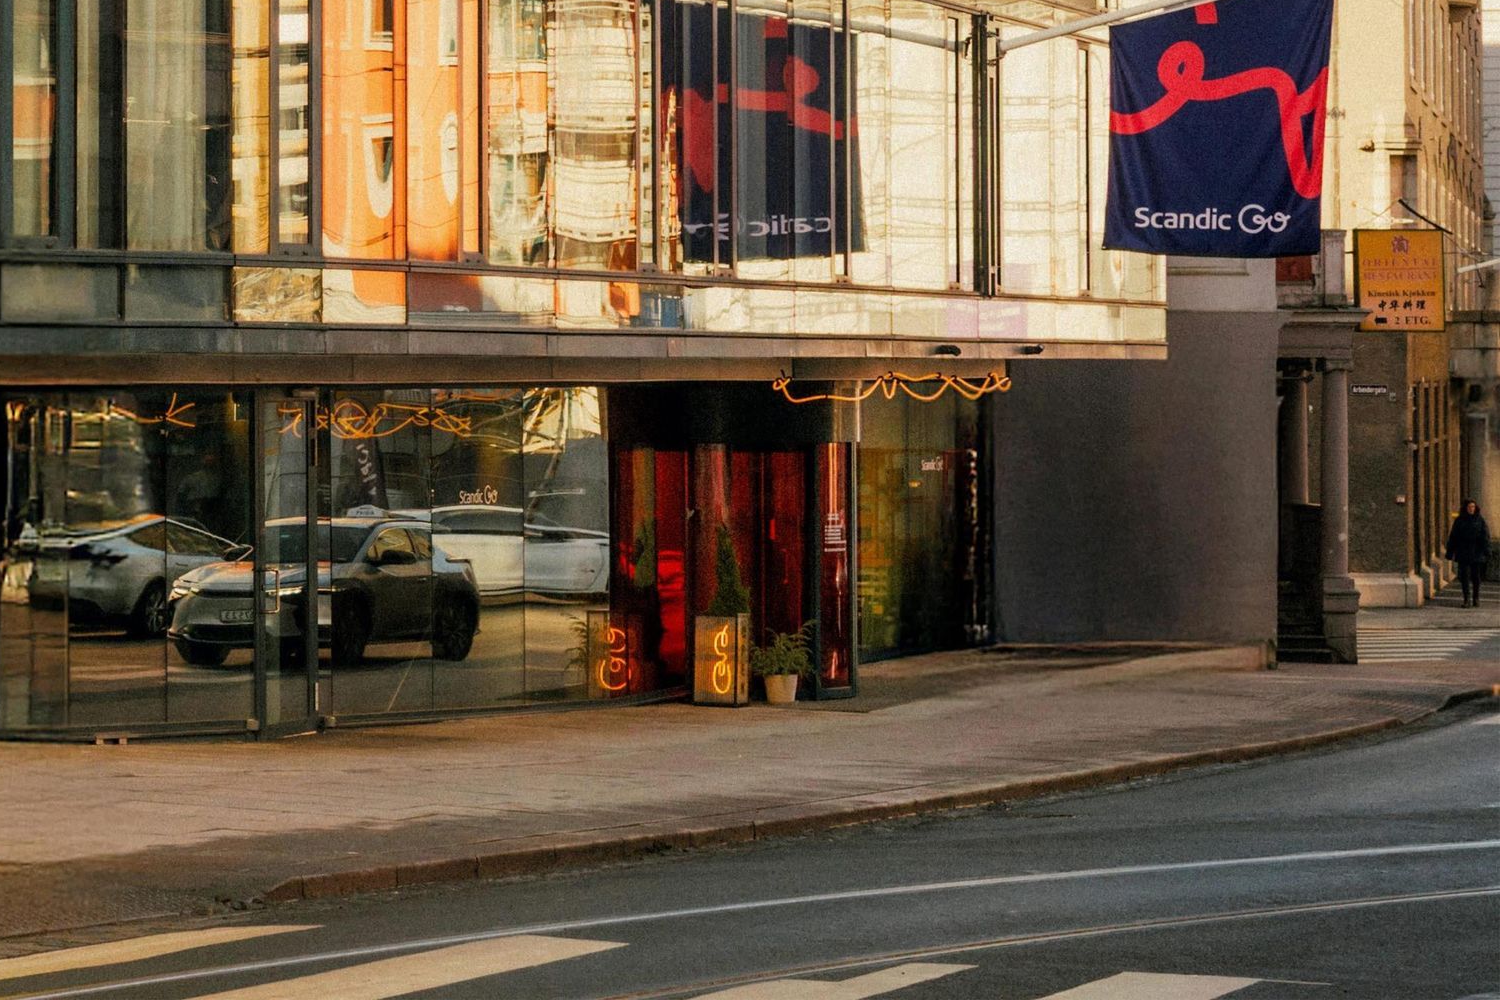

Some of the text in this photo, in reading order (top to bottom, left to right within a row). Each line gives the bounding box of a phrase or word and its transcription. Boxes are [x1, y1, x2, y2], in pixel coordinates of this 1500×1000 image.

[1134, 203, 1291, 234] Scandic Go
[1395, 316, 1432, 325] 2 ETG.
